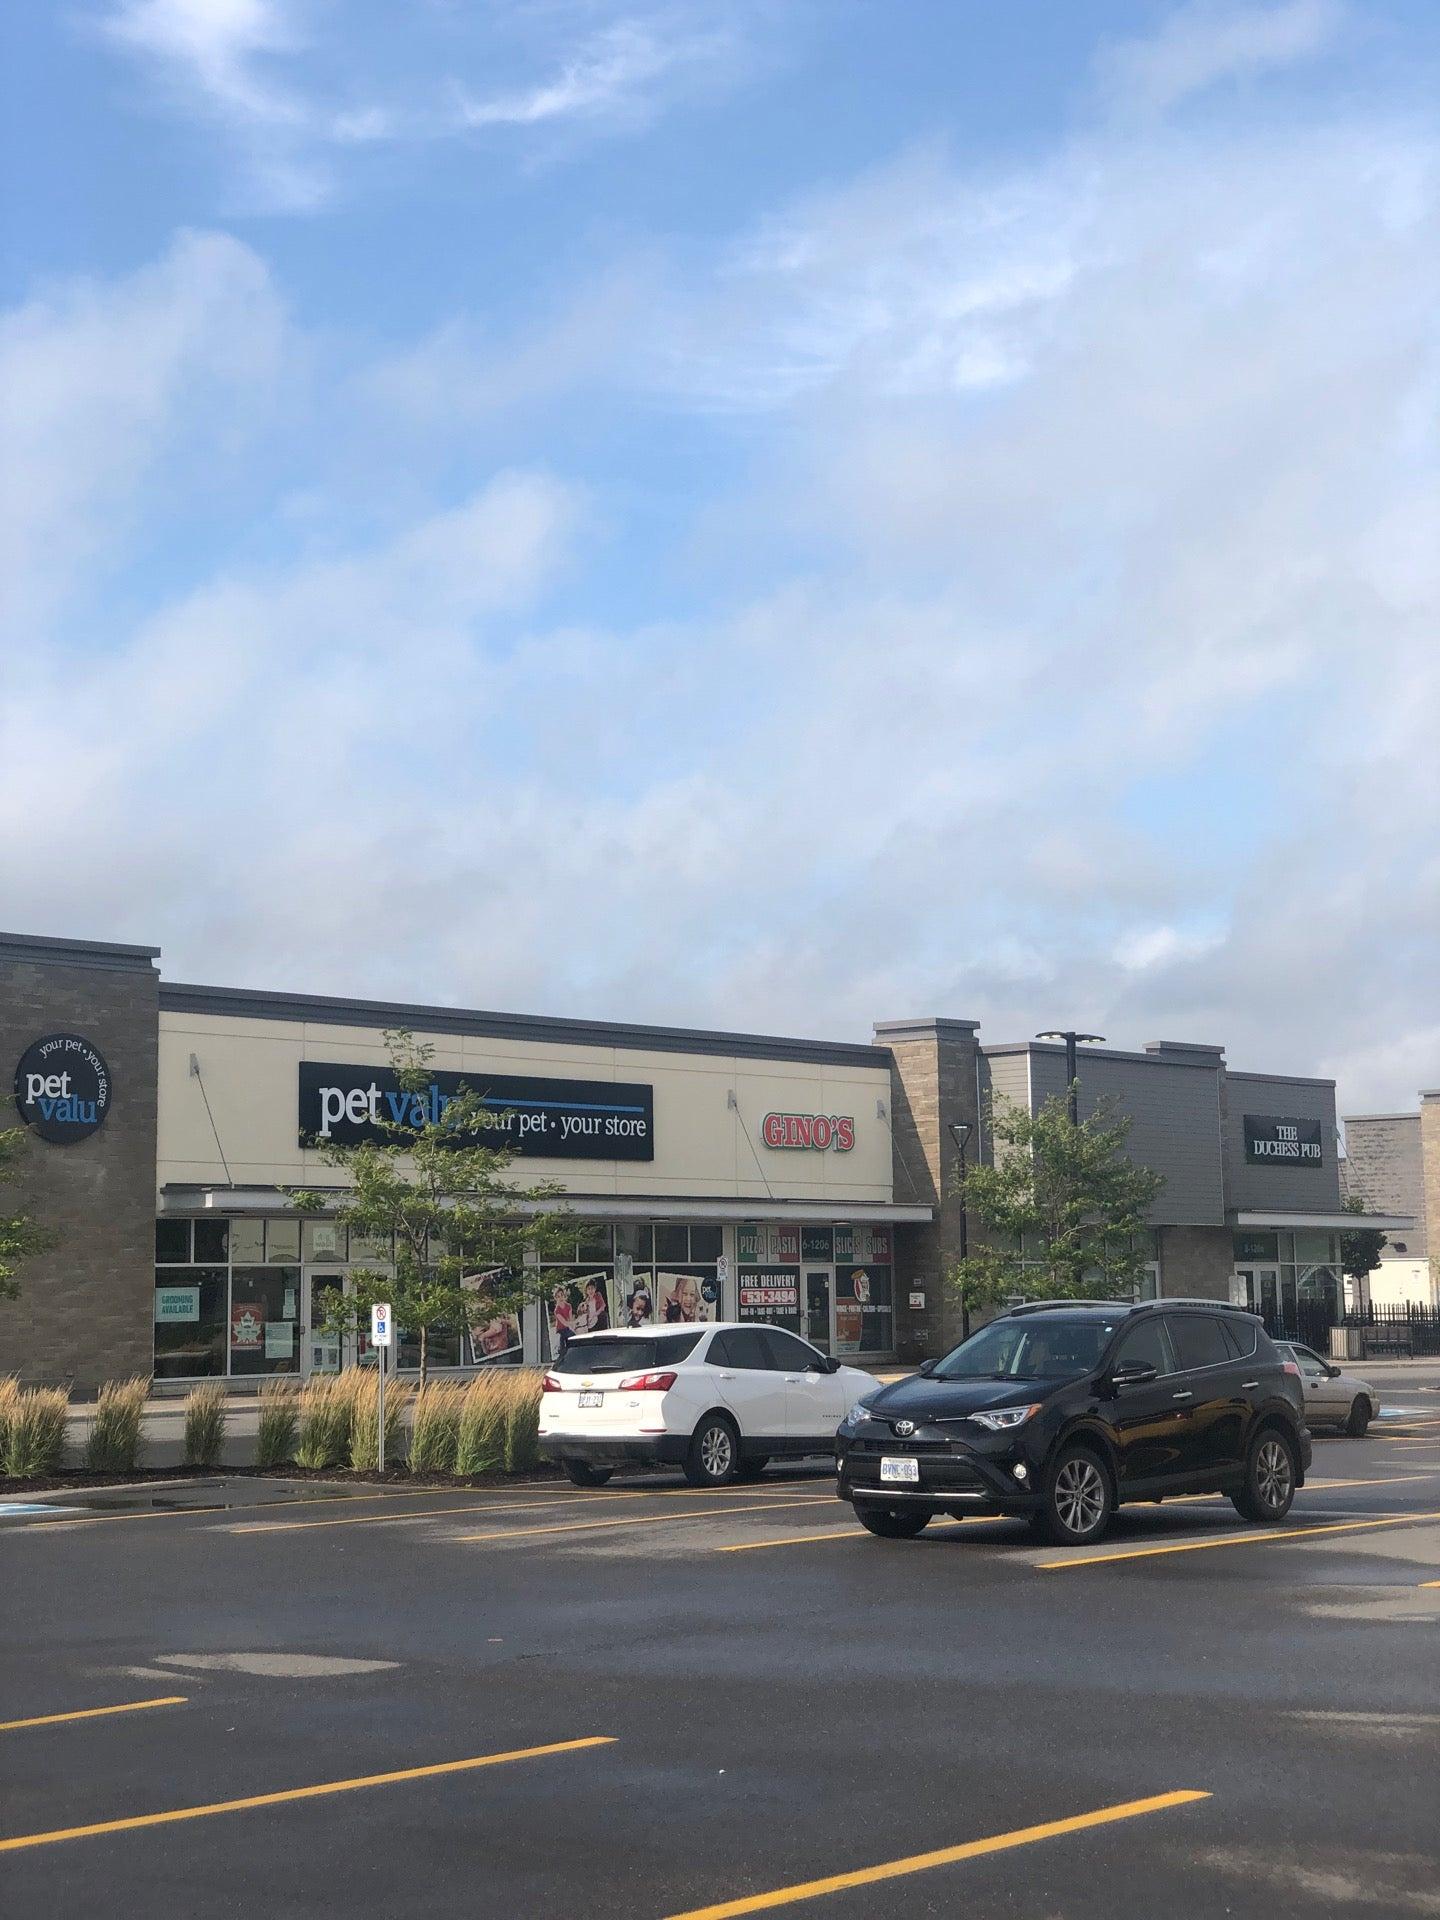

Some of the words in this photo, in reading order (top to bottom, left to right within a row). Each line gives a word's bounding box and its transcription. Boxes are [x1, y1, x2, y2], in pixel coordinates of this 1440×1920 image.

[40, 1040, 63, 1059] your
[65, 1040, 82, 1053] pet
[84, 1051, 105, 1076] your
[97, 1078, 108, 1108] store
[26, 1071, 72, 1105] pet
[38, 1094, 98, 1123] valu
[318, 1082, 382, 1137] pet
[518, 1111, 547, 1138] pet
[560, 1115, 601, 1140] your
[605, 1115, 647, 1138] store
[763, 1112, 855, 1151] GINO'S
[1276, 1126, 1298, 1141] THE
[1253, 1140, 1300, 1157] DUCHESS
[1301, 1143, 1321, 1158] PUB
[740, 1236, 764, 1254] PIZZA
[771, 1235, 797, 1254] PASTA
[866, 1236, 889, 1254] SUBS
[740, 1275, 759, 1288] FREE
[760, 1274, 796, 1287] DELIVERY
[162, 1294, 194, 1304] GROOMING
[161, 1304, 194, 1314] AVAILABLE
